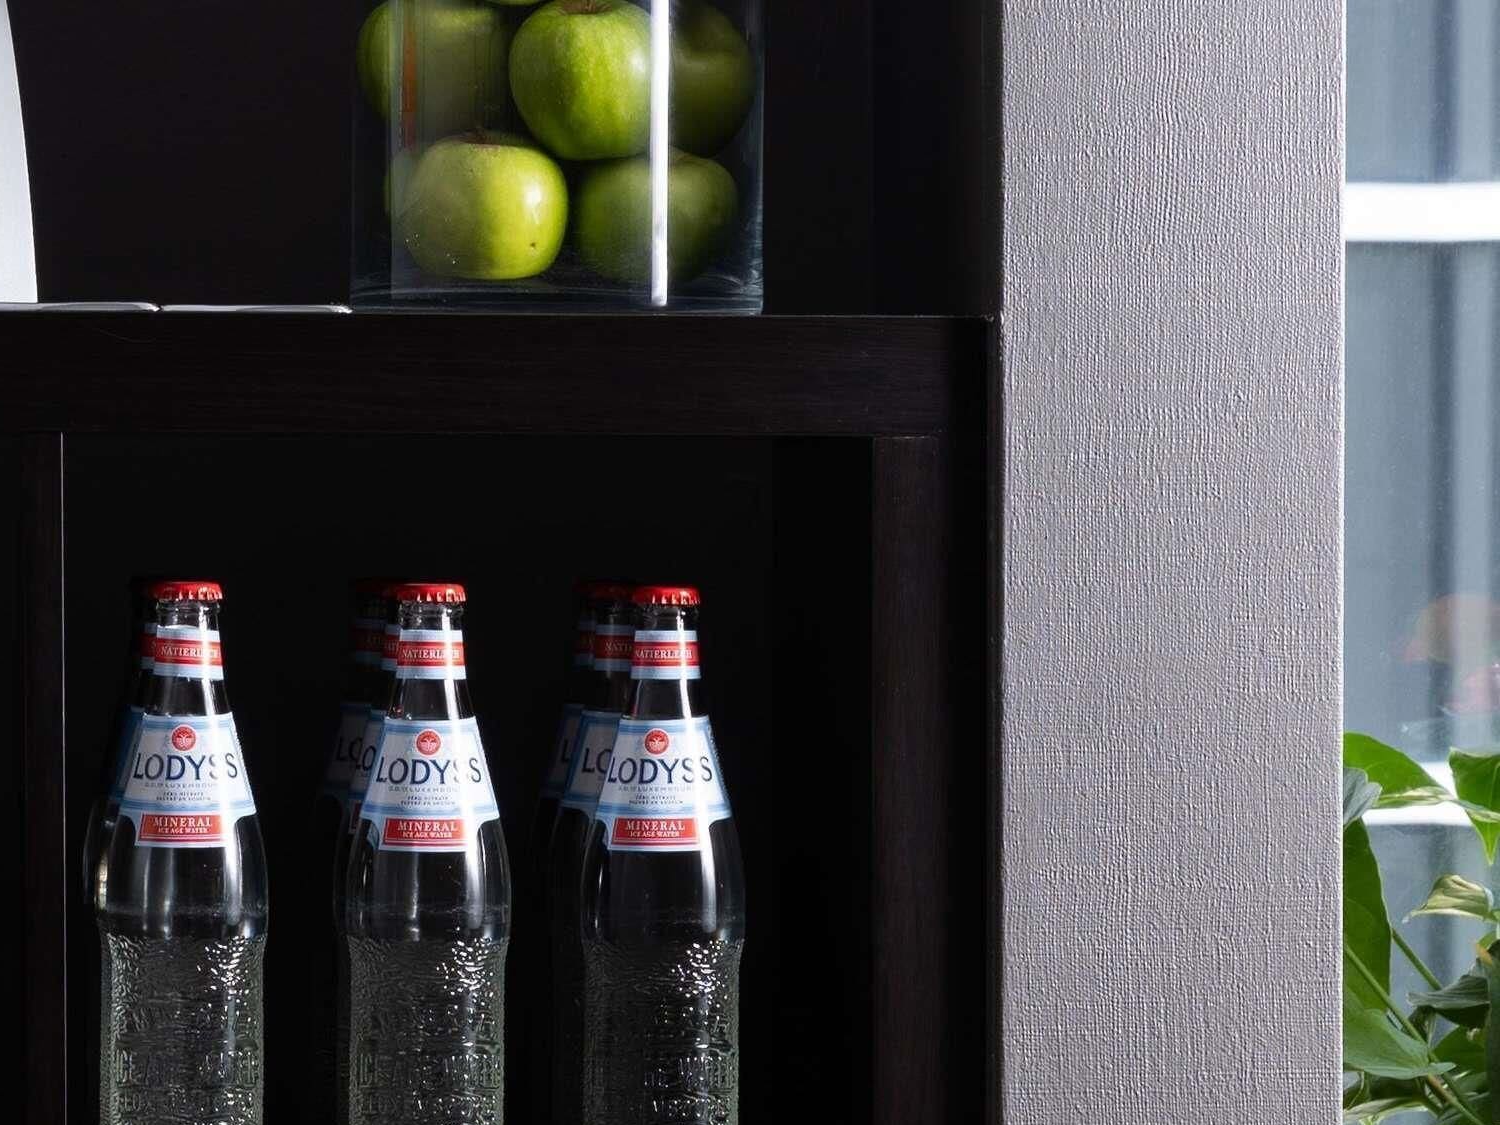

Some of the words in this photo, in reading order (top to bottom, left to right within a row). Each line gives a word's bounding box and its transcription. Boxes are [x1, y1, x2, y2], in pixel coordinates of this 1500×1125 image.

[133, 752, 238, 780] LODYSS
[607, 756, 713, 784] LODYSS
[154, 816, 213, 827] MINERAL
[397, 821, 457, 832] MINERAL
[626, 820, 685, 831] MINERAL
